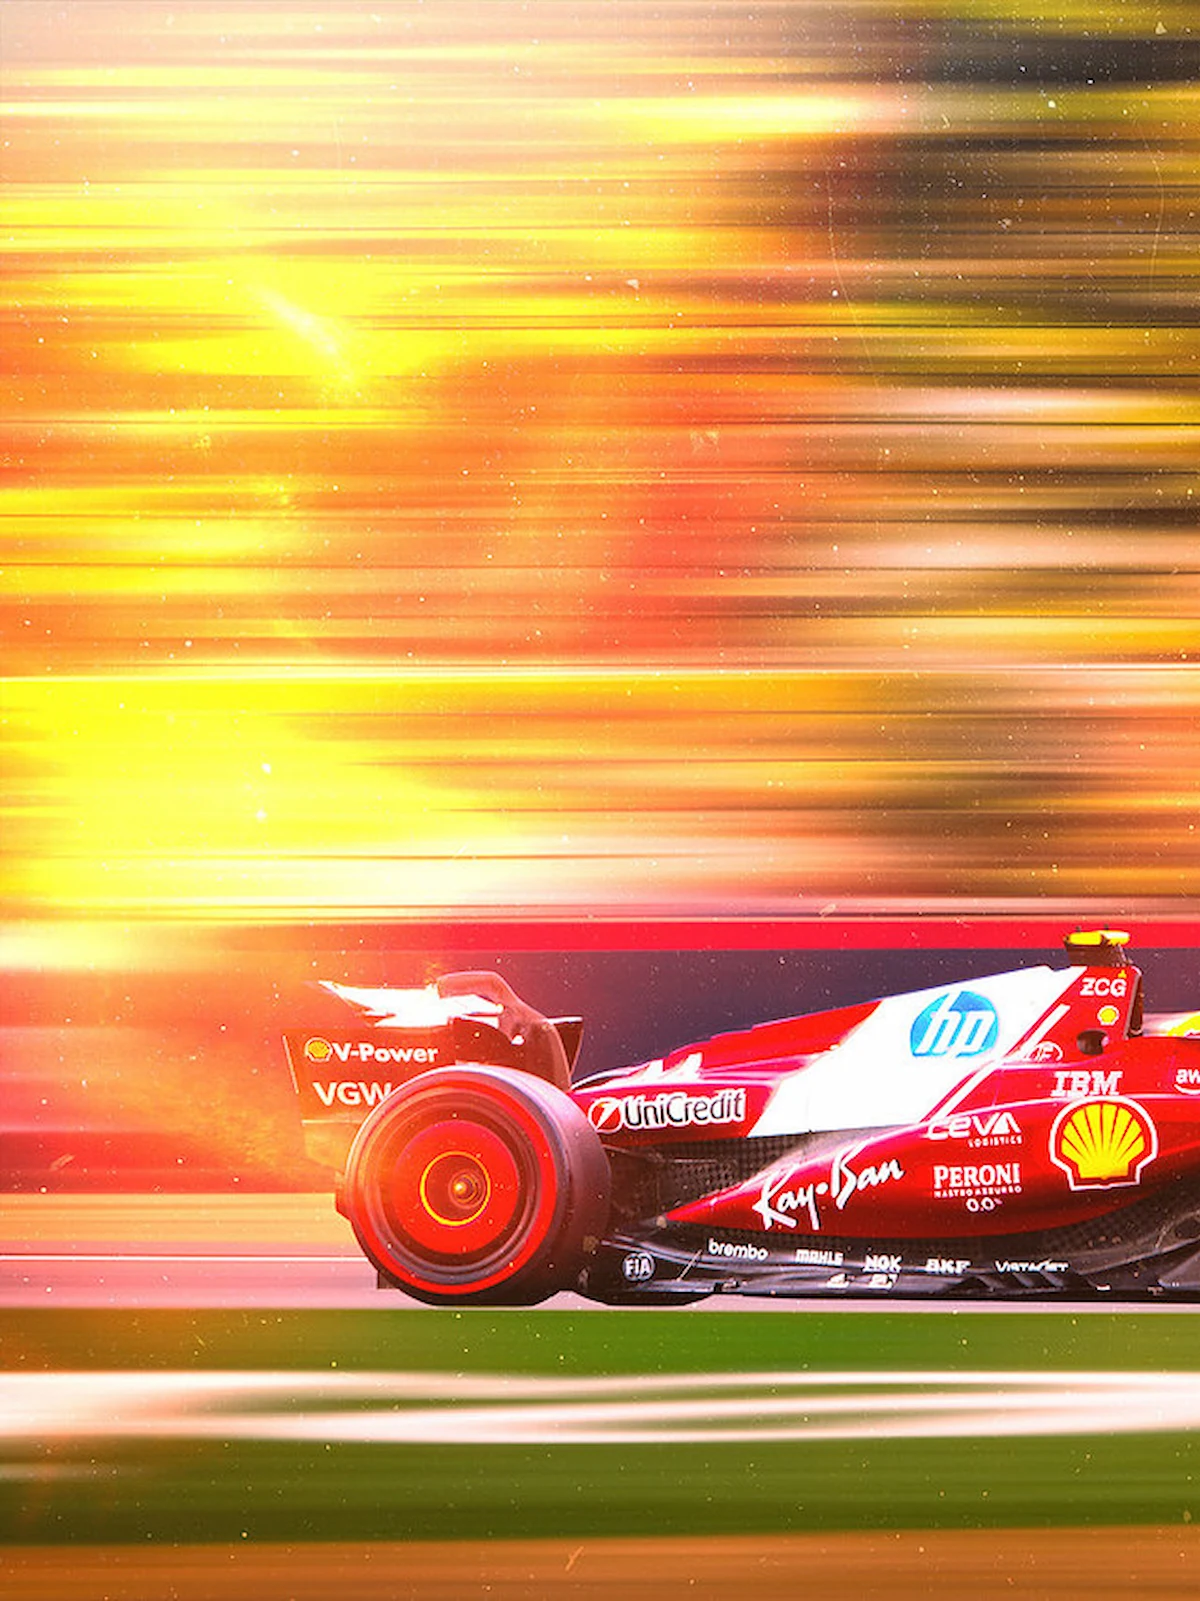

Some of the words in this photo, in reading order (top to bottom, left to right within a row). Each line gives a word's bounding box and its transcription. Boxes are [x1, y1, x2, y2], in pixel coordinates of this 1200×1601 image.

[1079, 977, 1127, 997] ZCG
[912, 991, 997, 1058] hp
[332, 1043, 438, 1063] V-Power
[312, 1082, 392, 1106] VGW
[1051, 1070, 1123, 1098] IBM
[623, 1089, 744, 1128] UniCredit
[933, 1163, 1020, 1189] PERONI
[708, 1238, 768, 1261] brembo
[624, 1254, 654, 1280] FIA
